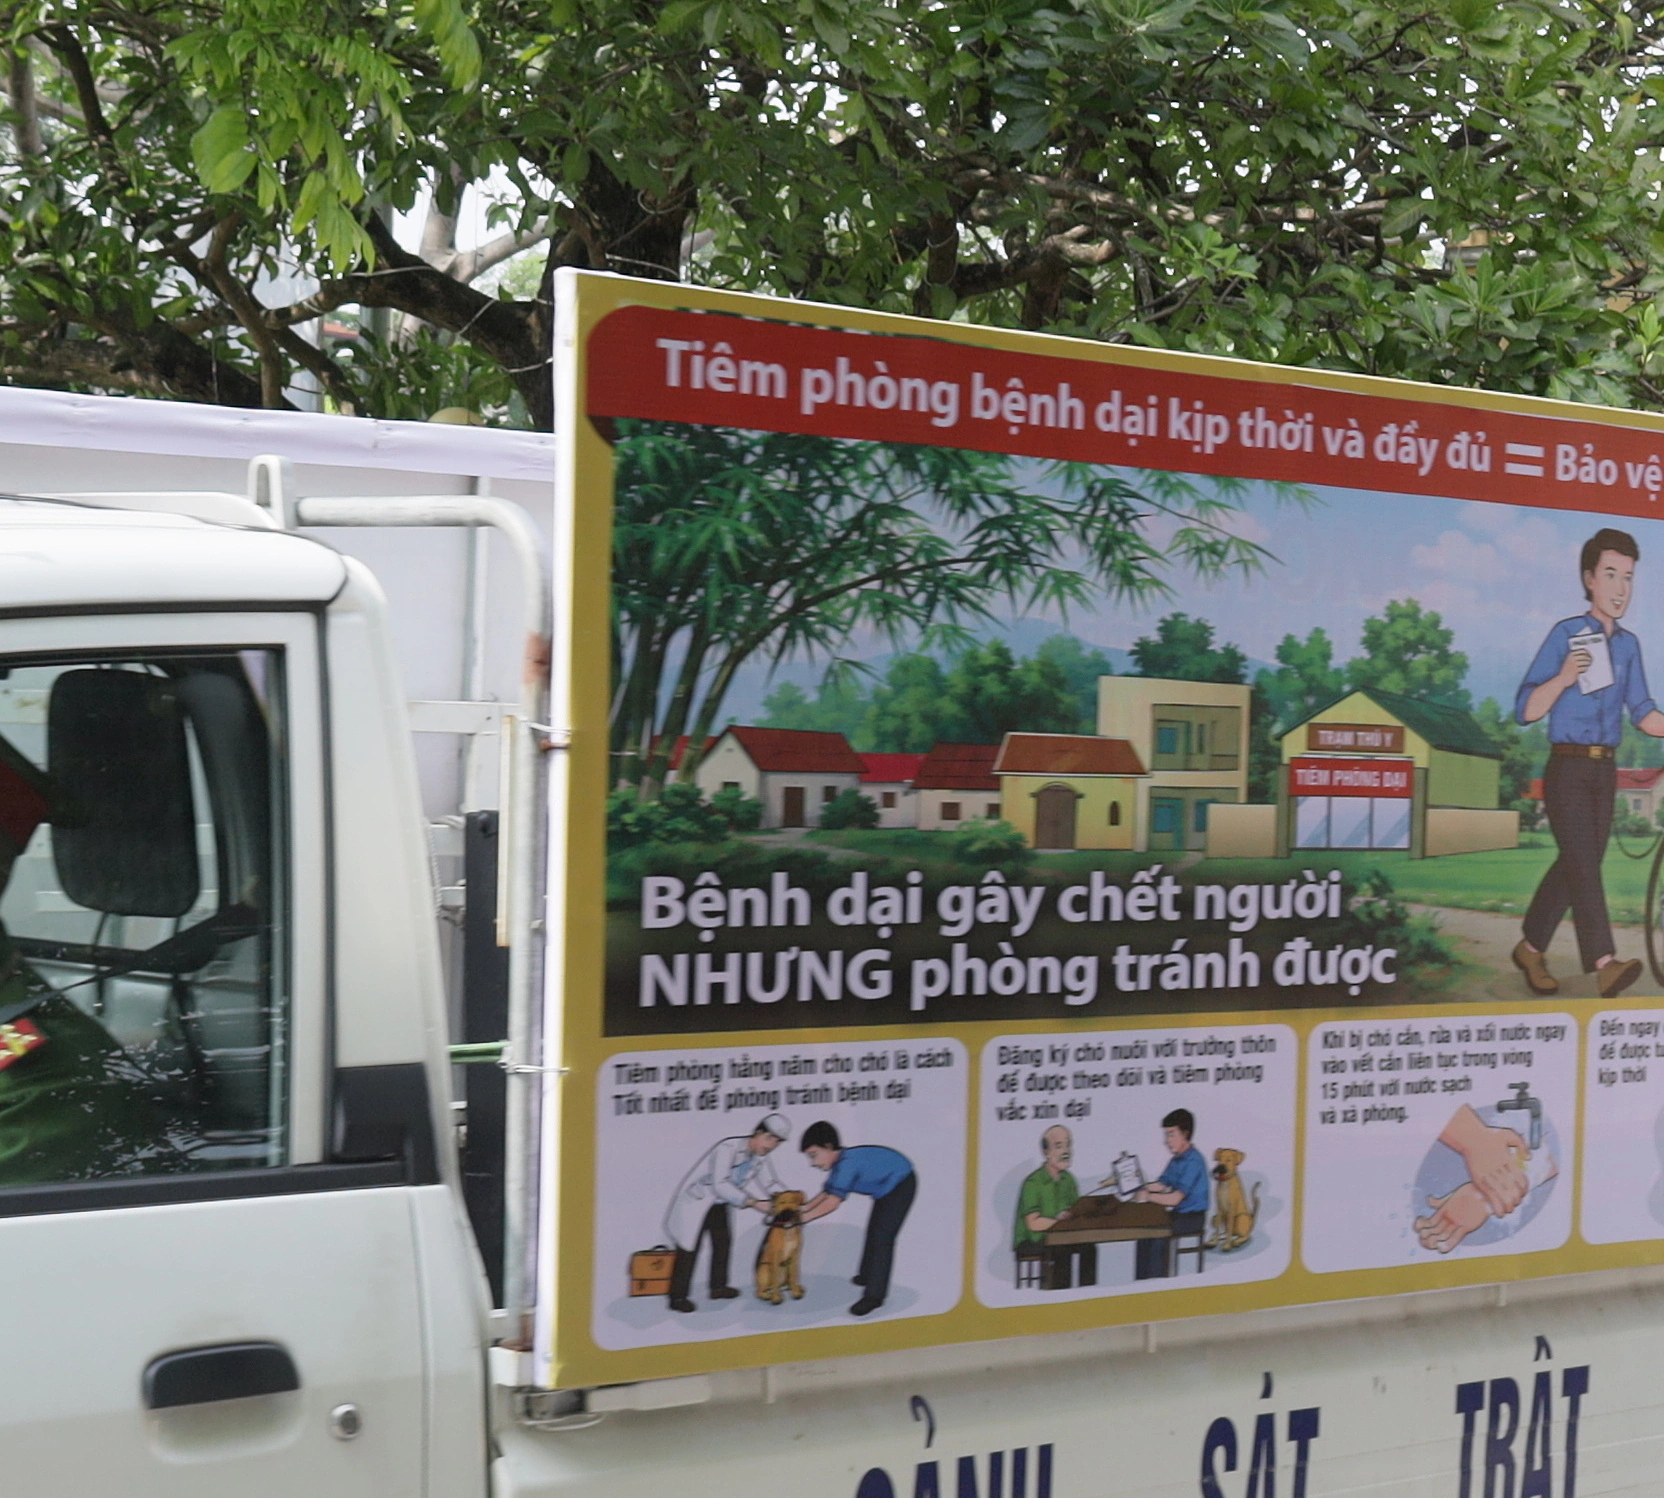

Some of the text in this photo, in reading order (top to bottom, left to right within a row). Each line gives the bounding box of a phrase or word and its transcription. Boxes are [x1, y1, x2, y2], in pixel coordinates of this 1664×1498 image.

[656, 337, 787, 399] Tiêm
[801, 356, 959, 427] phòng
[971, 372, 1085, 435] bệnh
[1095, 390, 1157, 446] dại
[1169, 398, 1229, 454] kịp
[1238, 407, 1314, 452] thời
[1322, 419, 1365, 459] và
[1374, 420, 1439, 476] đầy
[1446, 431, 1491, 472] đủ
[1556, 443, 1618, 485] Bảo
[1626, 454, 1661, 501] vệ
[1296, 765, 1407, 791] TIÊM PHÒNG DẠI
[641, 865, 1341, 942] Bệnh dại gây chết người
[640, 937, 1397, 1011] NHƯNG phòng tránh được
[1322, 1030, 1344, 1049] Khi
[1350, 1030, 1363, 1050] bị
[1367, 1028, 1390, 1046] chó
[1456, 1025, 1472, 1043] và
[1500, 1024, 1530, 1040] nước
[1536, 1025, 1567, 1042] ngay
[1600, 1017, 1624, 1036] Đến
[1629, 1020, 1660, 1038] ngay
[612, 1061, 660, 1085] Tiêm
[667, 1060, 721, 1085] phòng
[778, 1055, 817, 1076] năm
[823, 1053, 853, 1074] cho
[859, 1050, 888, 1072] chó
[894, 1049, 910, 1070] là
[915, 1047, 954, 1069] cách
[998, 1034, 1276, 1067] Đăng ký chó nuôi với trưởng thôn
[1322, 1048, 1533, 1073] vào vết cắn liên tục trong vòng
[997, 1070, 1020, 1092] để
[1025, 1070, 1066, 1096] được
[1073, 1070, 1110, 1088] theo
[1147, 1066, 1166, 1084] và
[1173, 1064, 1208, 1083] tiêm
[1214, 1062, 1263, 1085] phòng
[1322, 1075, 1471, 1100] 15 phút với nước sạch
[611, 1080, 911, 1116] Tốt nhất để phòng tránh bệnh dại
[1320, 1105, 1335, 1124] và
[1341, 1105, 1357, 1123] xà
